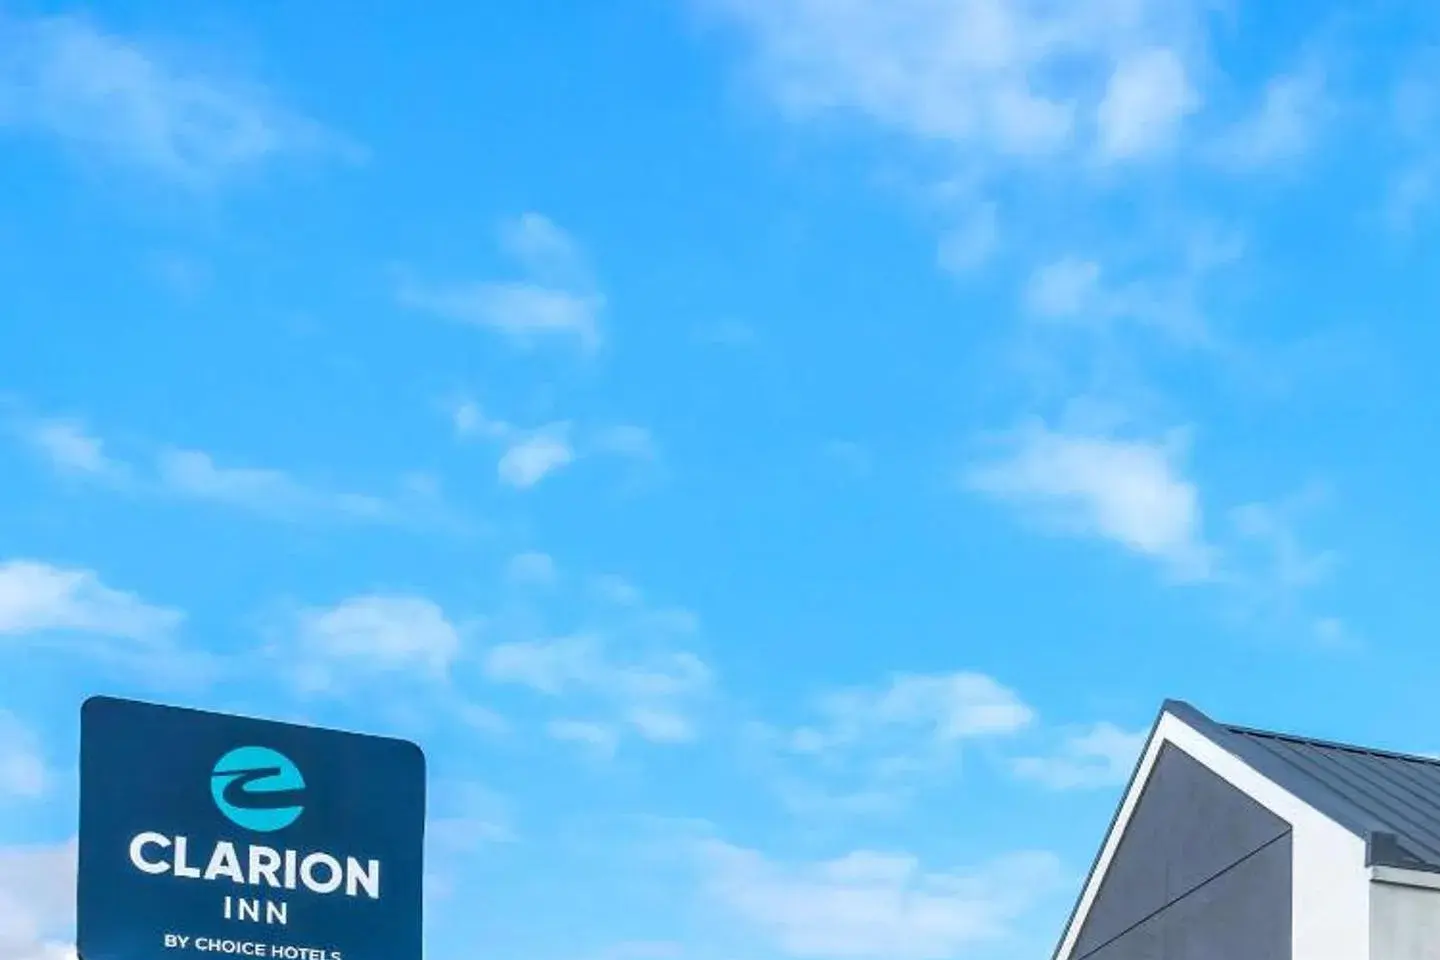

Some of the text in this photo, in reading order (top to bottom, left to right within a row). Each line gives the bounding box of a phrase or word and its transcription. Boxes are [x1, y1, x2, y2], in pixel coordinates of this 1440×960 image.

[129, 832, 380, 900] CLARION
[223, 896, 288, 925] INN
[164, 934, 189, 949] BY
[195, 937, 266, 957] CHOICE
